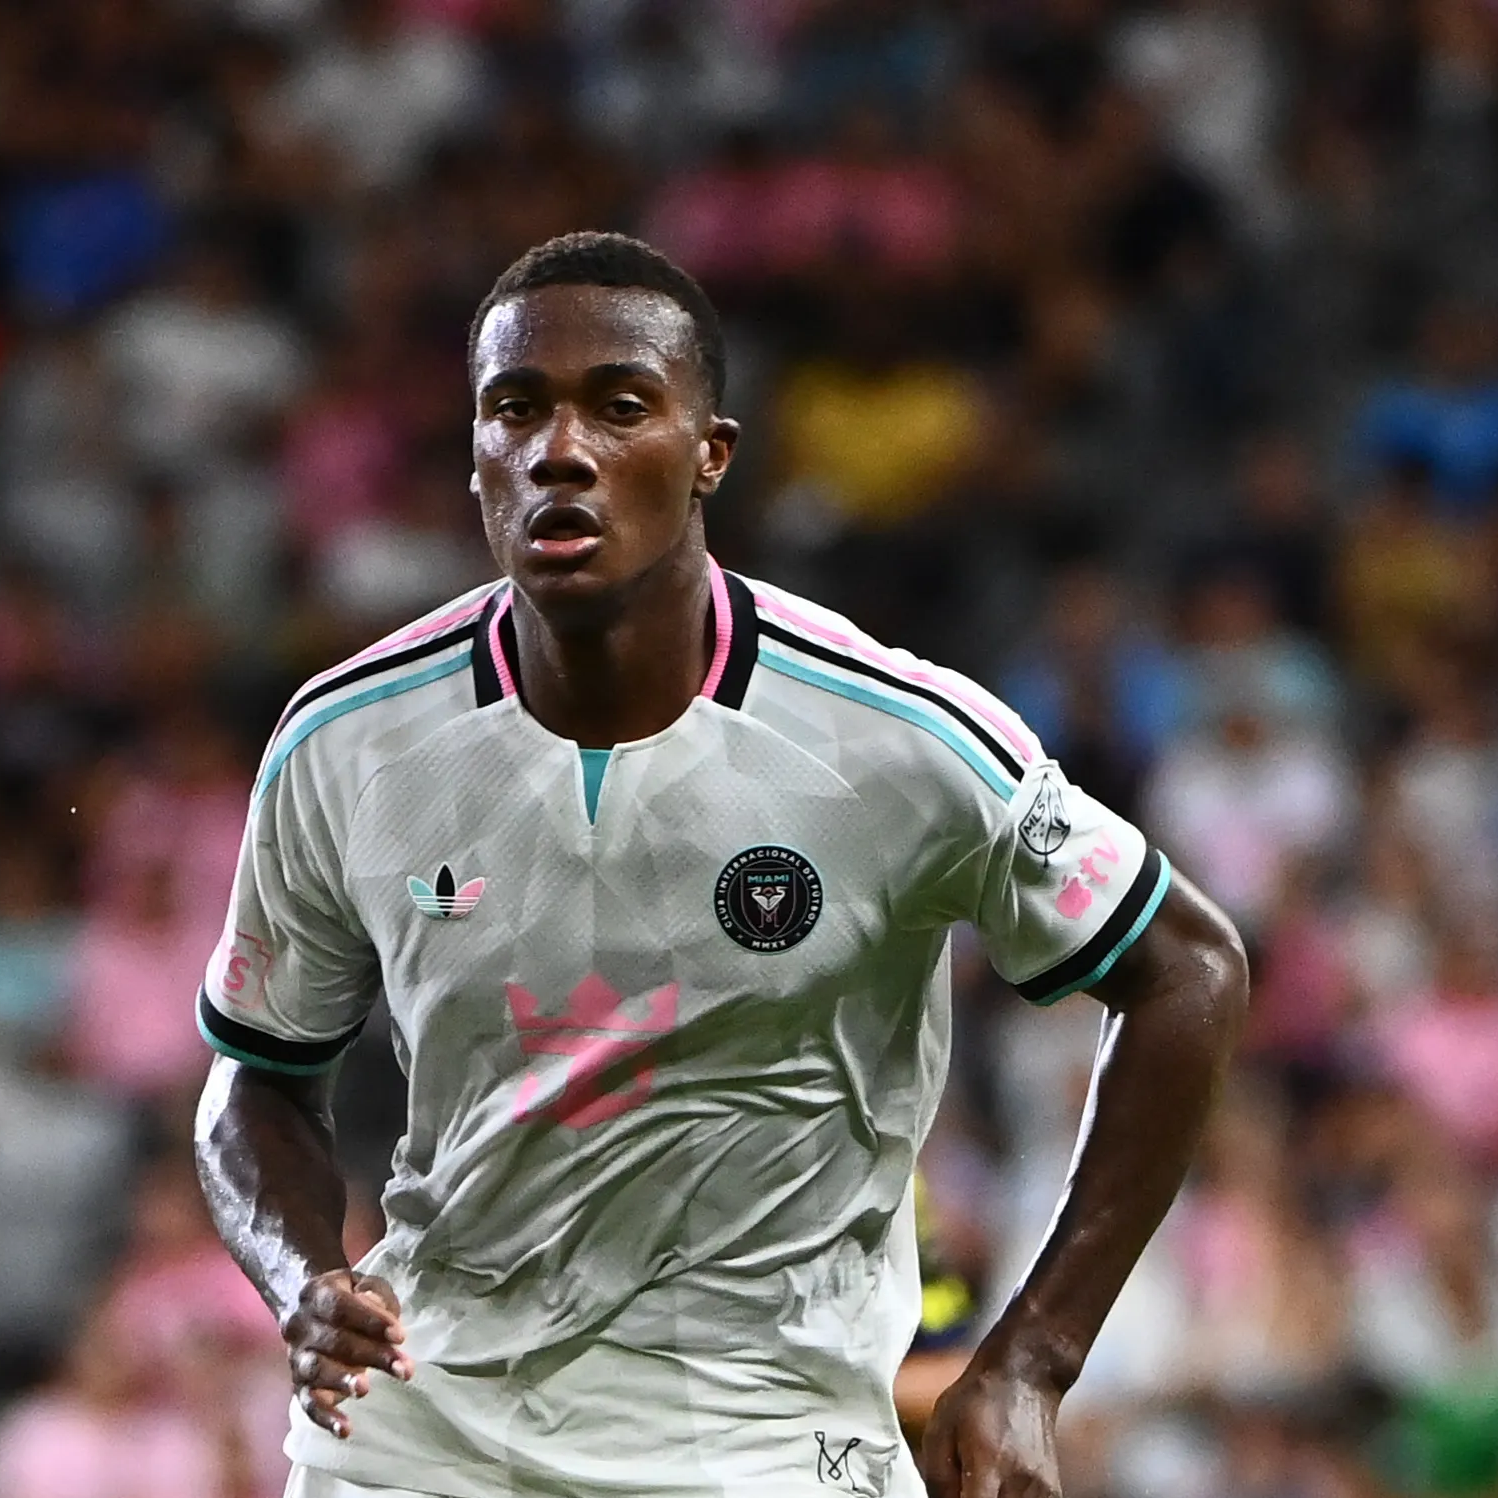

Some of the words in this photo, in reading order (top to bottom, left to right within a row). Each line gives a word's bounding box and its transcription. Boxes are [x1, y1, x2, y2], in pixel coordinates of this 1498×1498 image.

[1024, 798, 1046, 836] MLS
[718, 849, 802, 893] INTERNACIONAL
[747, 874, 790, 883] MIAMI
[803, 867, 815, 881] DE
[717, 899, 733, 928] CLUB
[752, 939, 787, 949] MMXX
